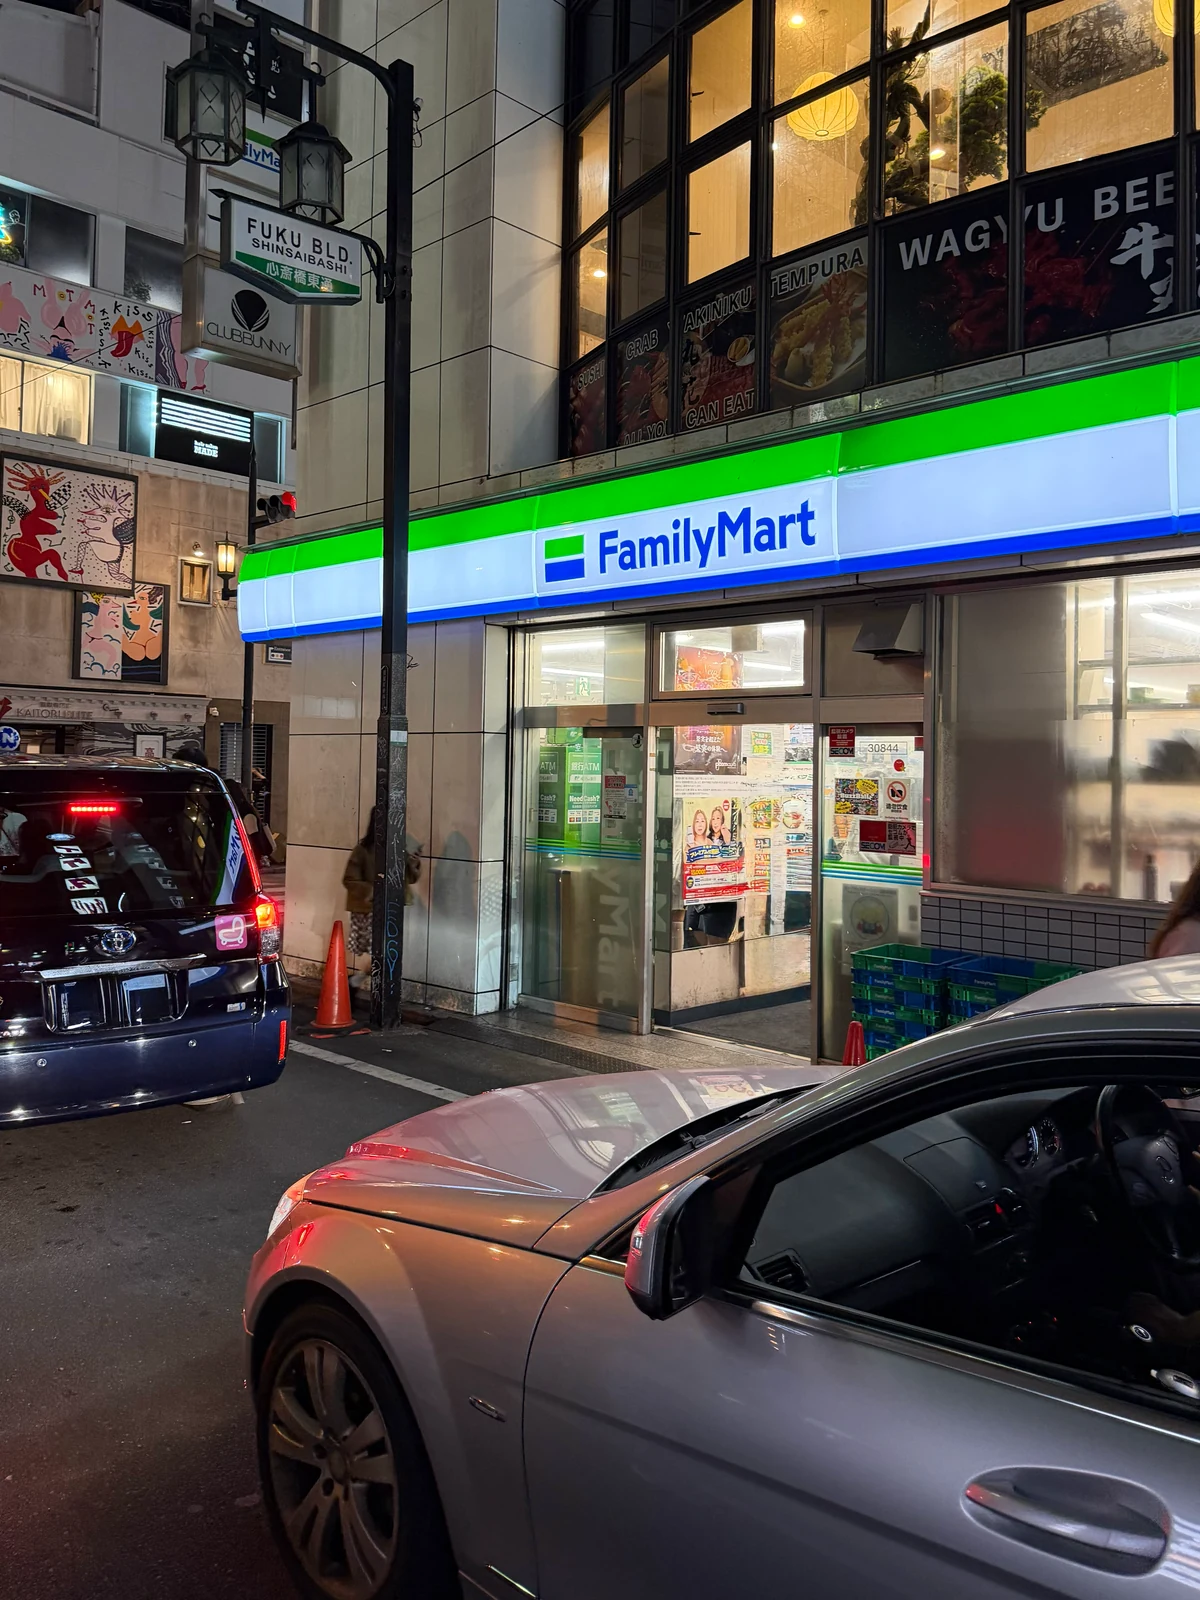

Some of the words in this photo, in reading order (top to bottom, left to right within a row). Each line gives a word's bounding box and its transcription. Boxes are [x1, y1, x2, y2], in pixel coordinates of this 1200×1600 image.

[898, 197, 1064, 270] WAGYU
[1094, 171, 1197, 221] BEE
[248, 217, 301, 248] FUKU
[312, 237, 353, 265] BLD.
[251, 237, 347, 275] SHINSAIBASHI
[770, 247, 865, 298] TEMPURA
[625, 328, 659, 361] CRAB
[577, 359, 606, 391] SUSHI
[685, 401, 719, 430] CAN
[722, 388, 756, 420] EAT
[193, 445, 219, 458] MADE
[599, 499, 816, 574] FamilyMart
[830, 747, 854, 755] SECOM
[867, 743, 899, 753] 30844
[860, 841, 886, 851] SECOM
